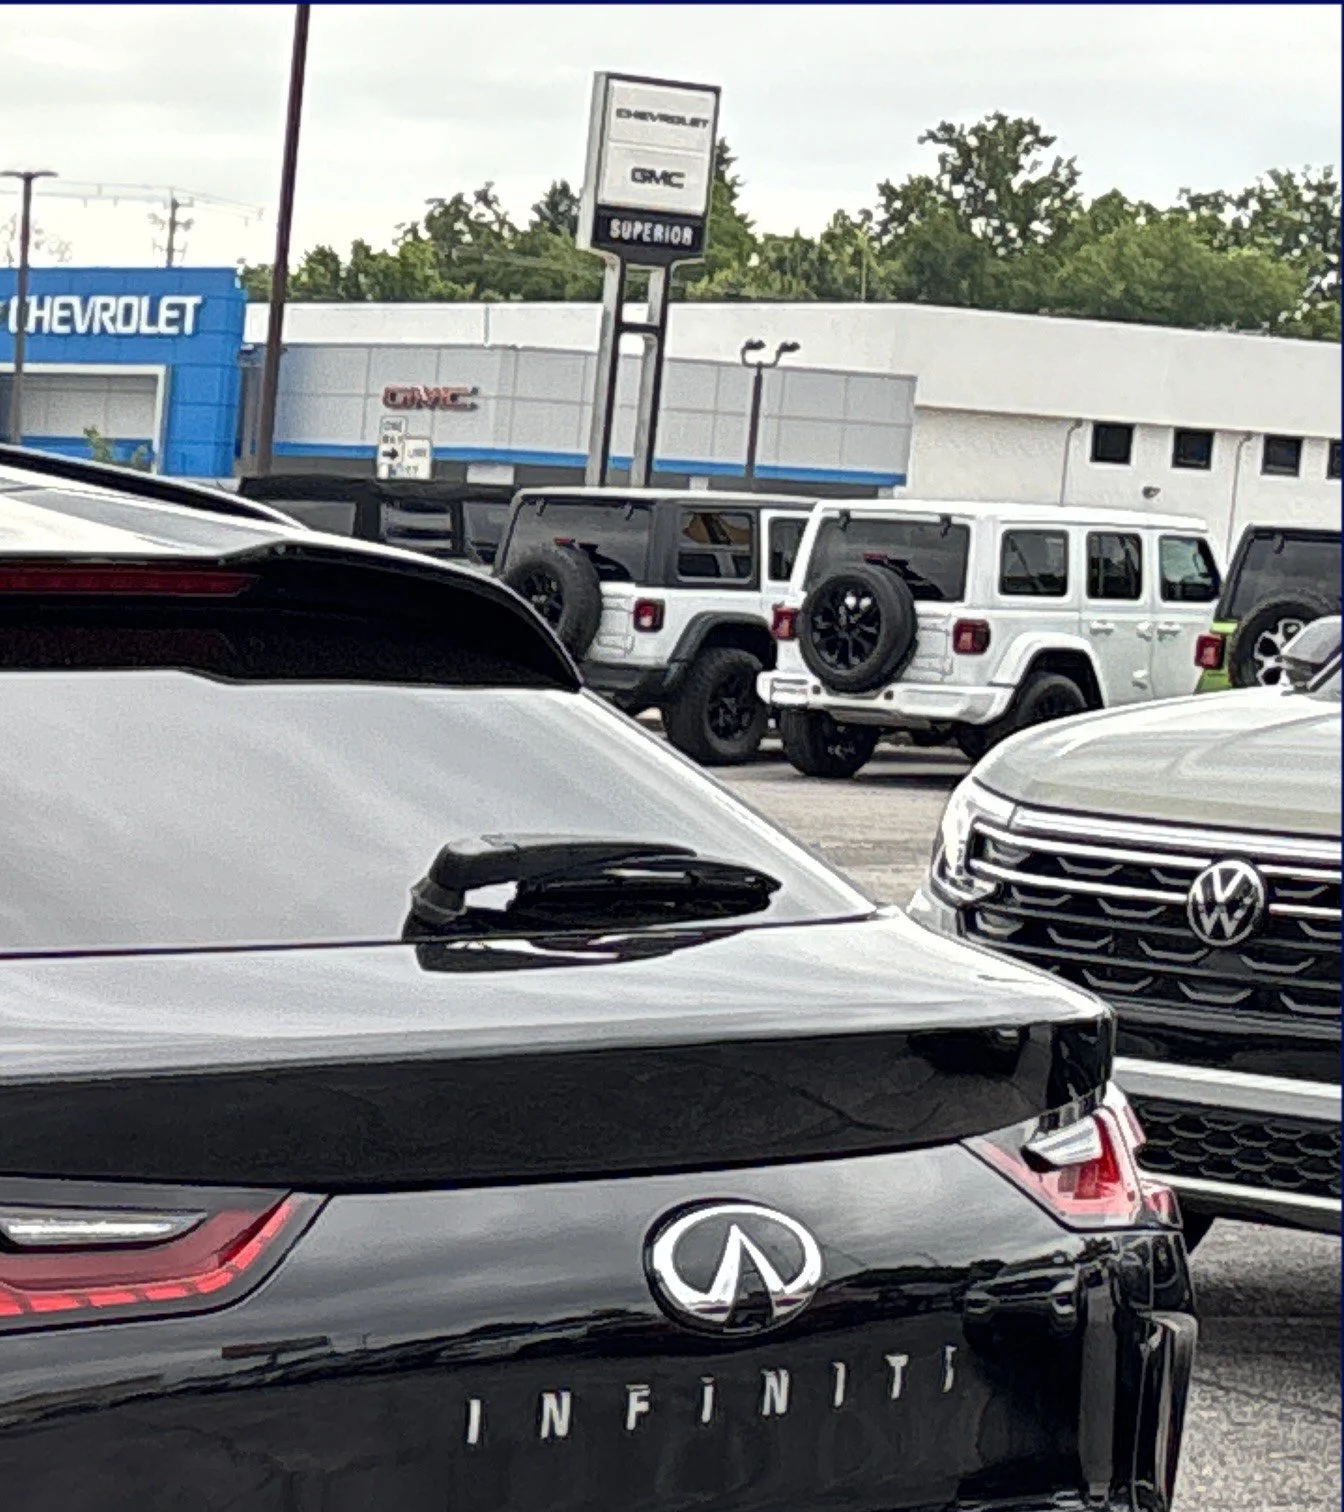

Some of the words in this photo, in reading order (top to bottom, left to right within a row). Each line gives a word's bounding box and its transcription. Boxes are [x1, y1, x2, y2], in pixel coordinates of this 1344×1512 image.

[630, 166, 685, 189] GMC
[609, 218, 694, 246] SUPERIOR
[7, 294, 203, 337] CHEVROLET
[381, 385, 480, 412] GMC
[465, 1345, 960, 1446] INFINITI
